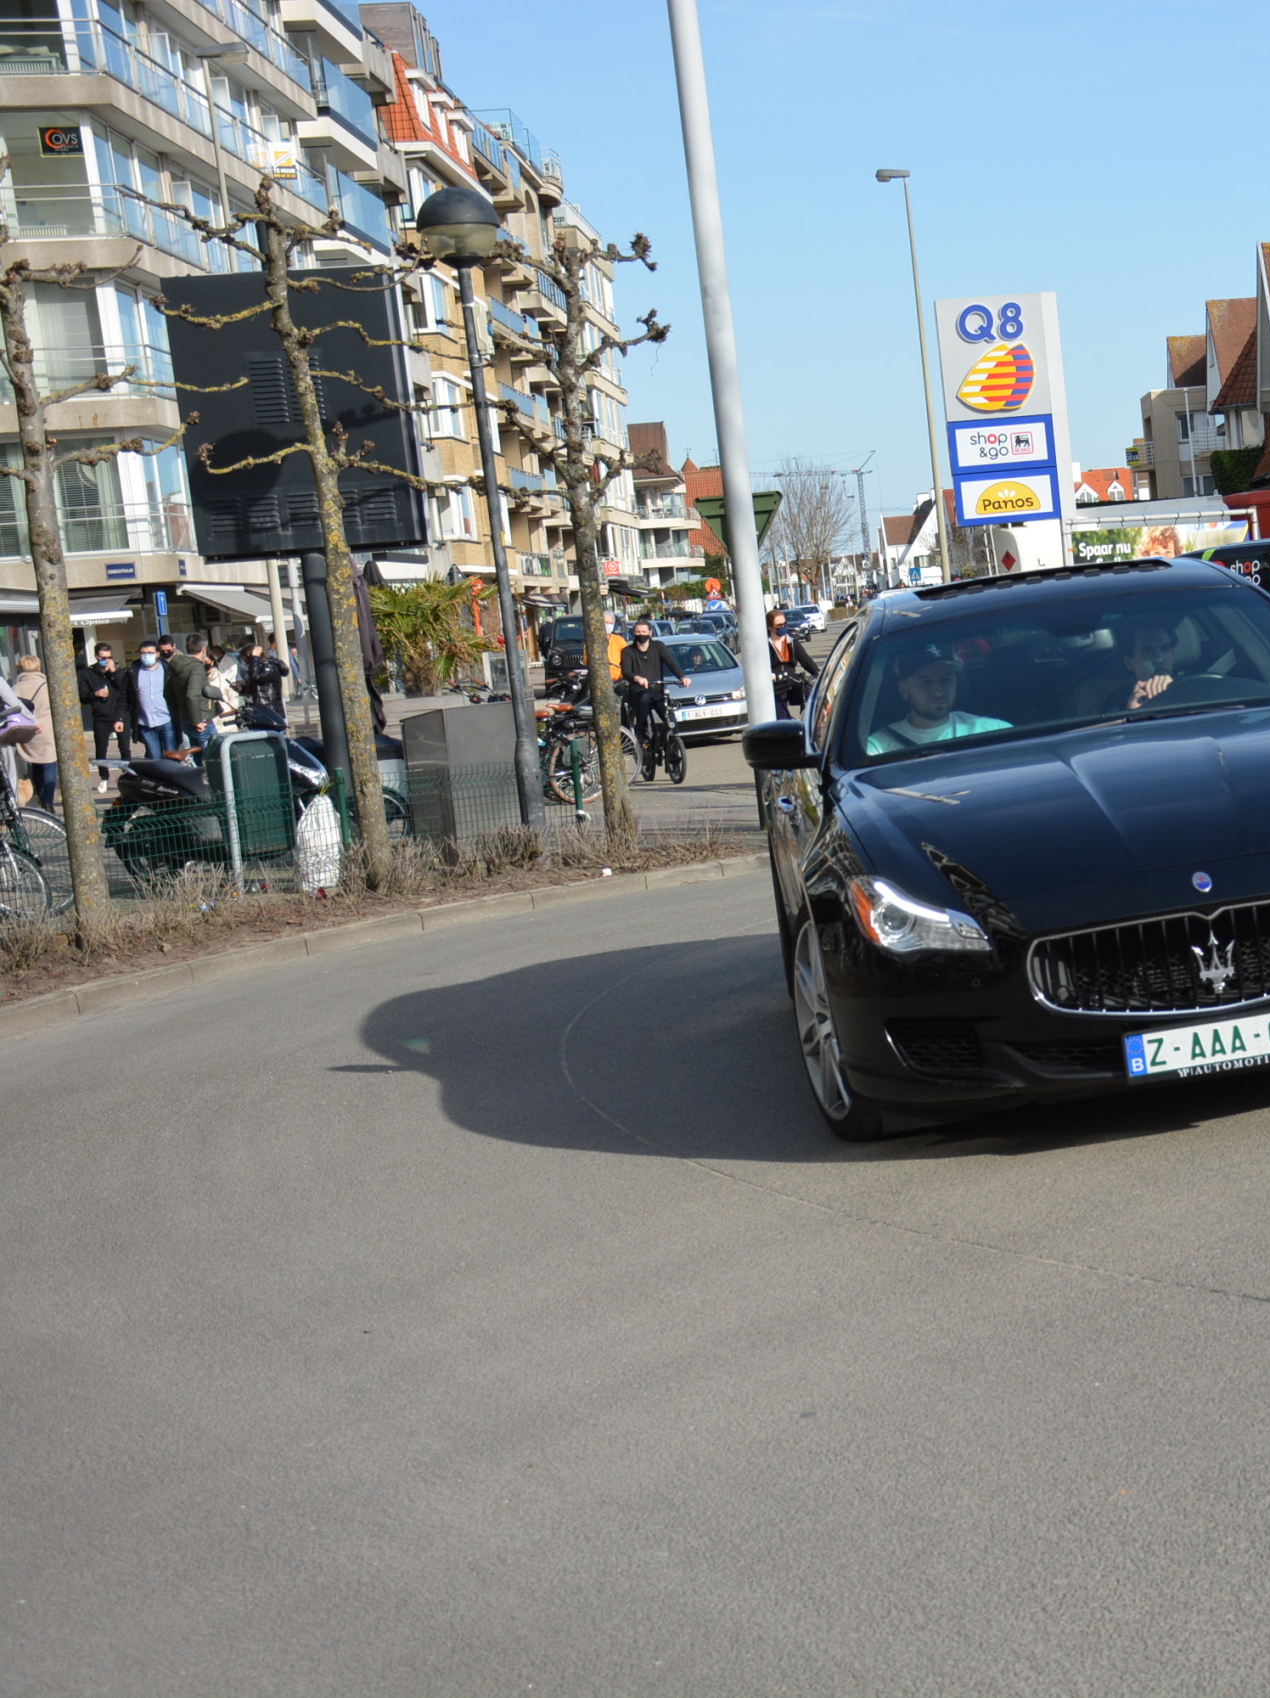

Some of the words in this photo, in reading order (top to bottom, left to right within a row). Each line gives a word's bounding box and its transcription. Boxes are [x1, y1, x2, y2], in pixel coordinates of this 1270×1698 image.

[957, 302, 1024, 342] Q8
[970, 432, 1008, 446] shop
[979, 446, 1009, 460] &go
[982, 497, 1034, 511] Panos
[1078, 542, 1113, 560] Spaar
[1115, 543, 1132, 555] nu
[1230, 560, 1260, 575] shop
[80, 619, 110, 627] Optics
[1131, 1058, 1144, 1072] B
